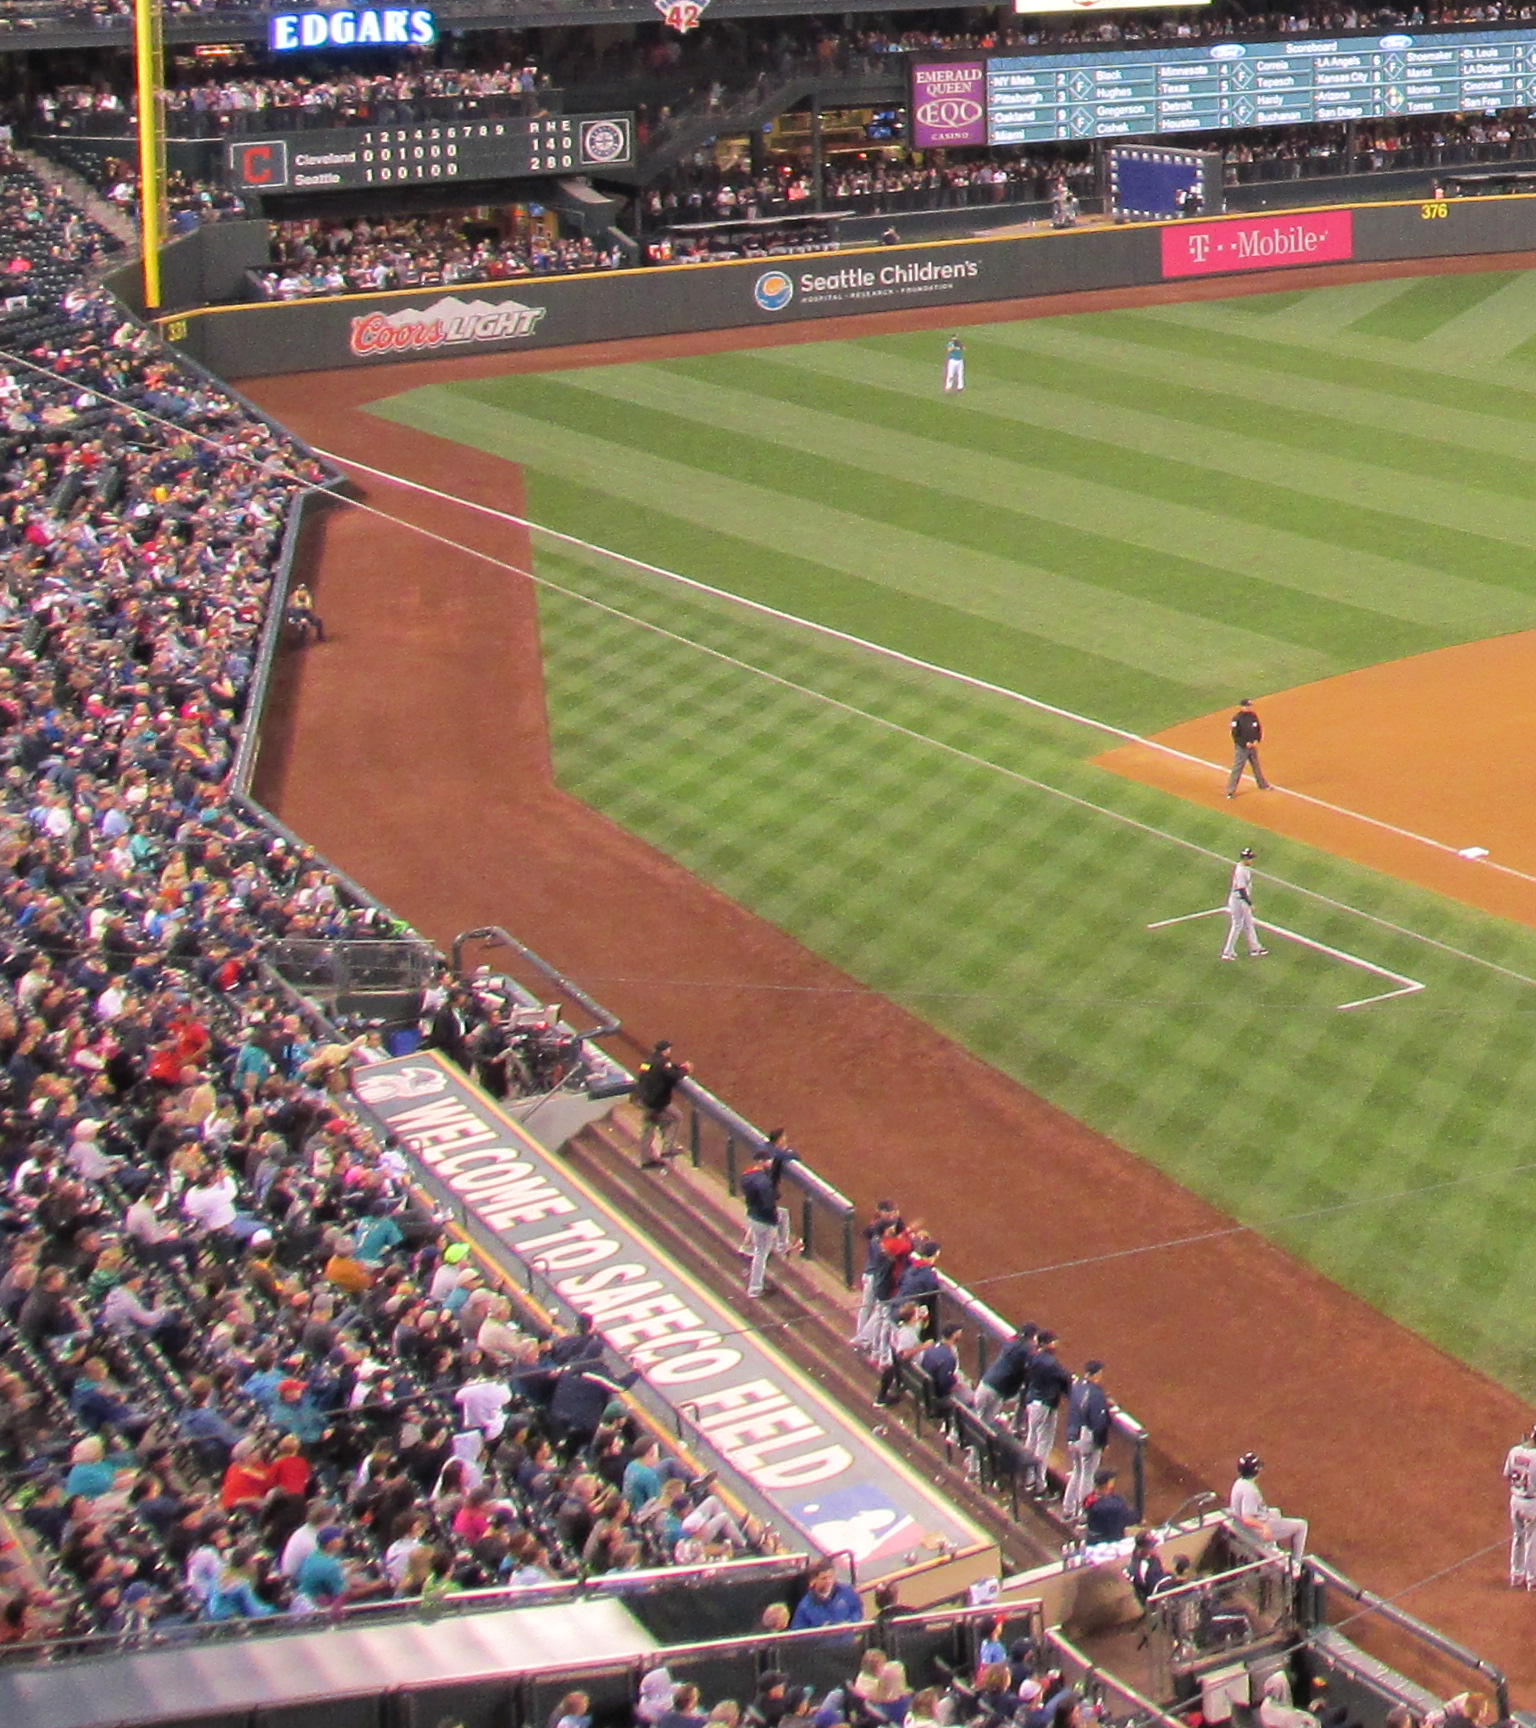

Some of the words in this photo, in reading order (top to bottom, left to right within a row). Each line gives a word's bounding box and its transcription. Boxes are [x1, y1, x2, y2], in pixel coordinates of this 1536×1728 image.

[668, 6, 698, 27] 42
[274, 10, 435, 50] EDGAR'S
[1286, 42, 1338, 54] Scoreboard
[916, 69, 982, 84] EMERALD
[1318, 74, 1347, 84] Kansas
[1350, 71, 1368, 84] City
[926, 82, 972, 98] QUEEN
[1096, 87, 1132, 100] Hughes
[1162, 83, 1190, 94] Texas
[1318, 90, 1350, 102] Arizona
[994, 110, 1036, 122] Oakland
[1097, 104, 1145, 118] Gregerson
[931, 132, 970, 141] CASINO
[242, 146, 272, 184] C
[295, 150, 355, 166] Cleveland
[295, 172, 340, 186] Seattle
[1421, 203, 1448, 220] 376
[800, 269, 876, 292] Seattle
[880, 260, 978, 284] Children's
[801, 292, 842, 303] HOSPITAL
[850, 289, 894, 299] RESEARCH
[900, 283, 953, 294] FOUNDATION
[350, 312, 444, 357] Coors
[442, 307, 545, 344] LIGHT
[386, 1096, 579, 1231] WELCOME
[513, 1216, 621, 1271] TO
[557, 1263, 743, 1386] SAFECO
[678, 1378, 855, 1490] FIELD
